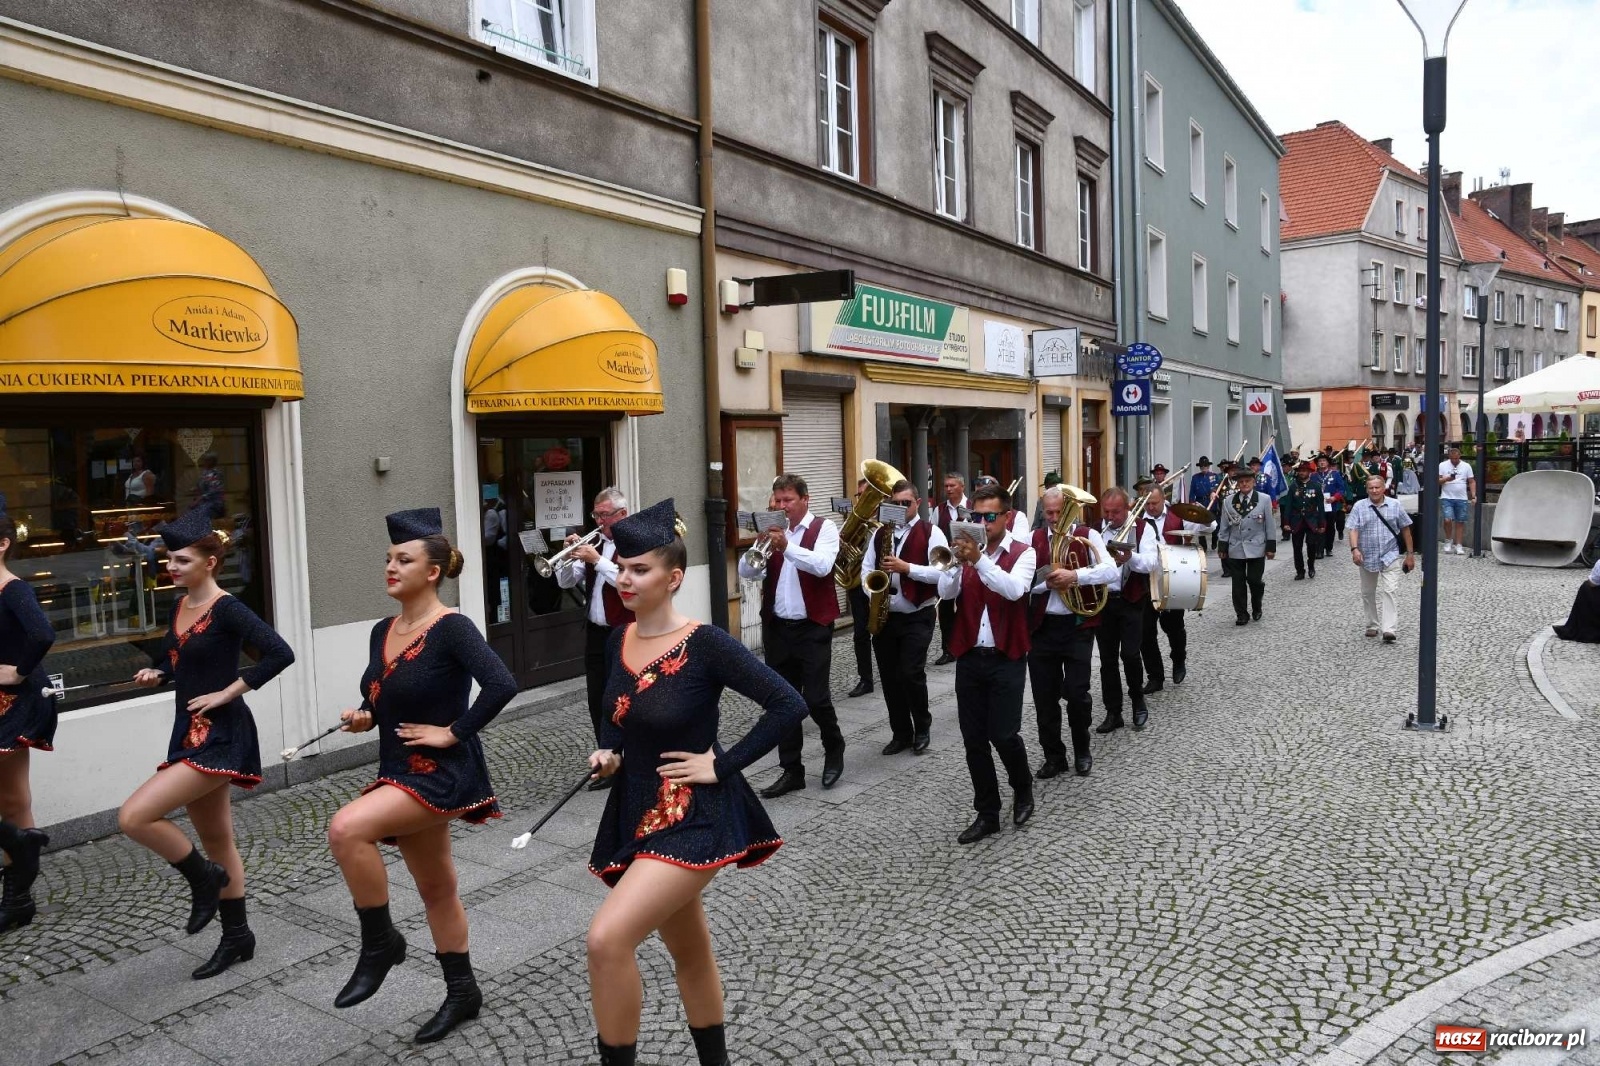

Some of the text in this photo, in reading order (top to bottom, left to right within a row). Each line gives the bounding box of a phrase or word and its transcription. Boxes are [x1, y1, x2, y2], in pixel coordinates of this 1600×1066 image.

[185, 305, 213, 315] Anida
[222, 307, 246, 321] Adam
[862, 294, 936, 334] FUJIFILM
[169, 319, 261, 342] Markiewka
[27, 373, 125, 386] CUKIERNIA
[131, 374, 220, 387] PIEKARNIA
[222, 376, 282, 389] CUKIERNIA
[471, 399, 521, 408] PIEKARNIA
[524, 397, 585, 406] CUKIERNIA
[588, 397, 635, 407] PIEKARNIA
[1117, 404, 1148, 412] Monetia
